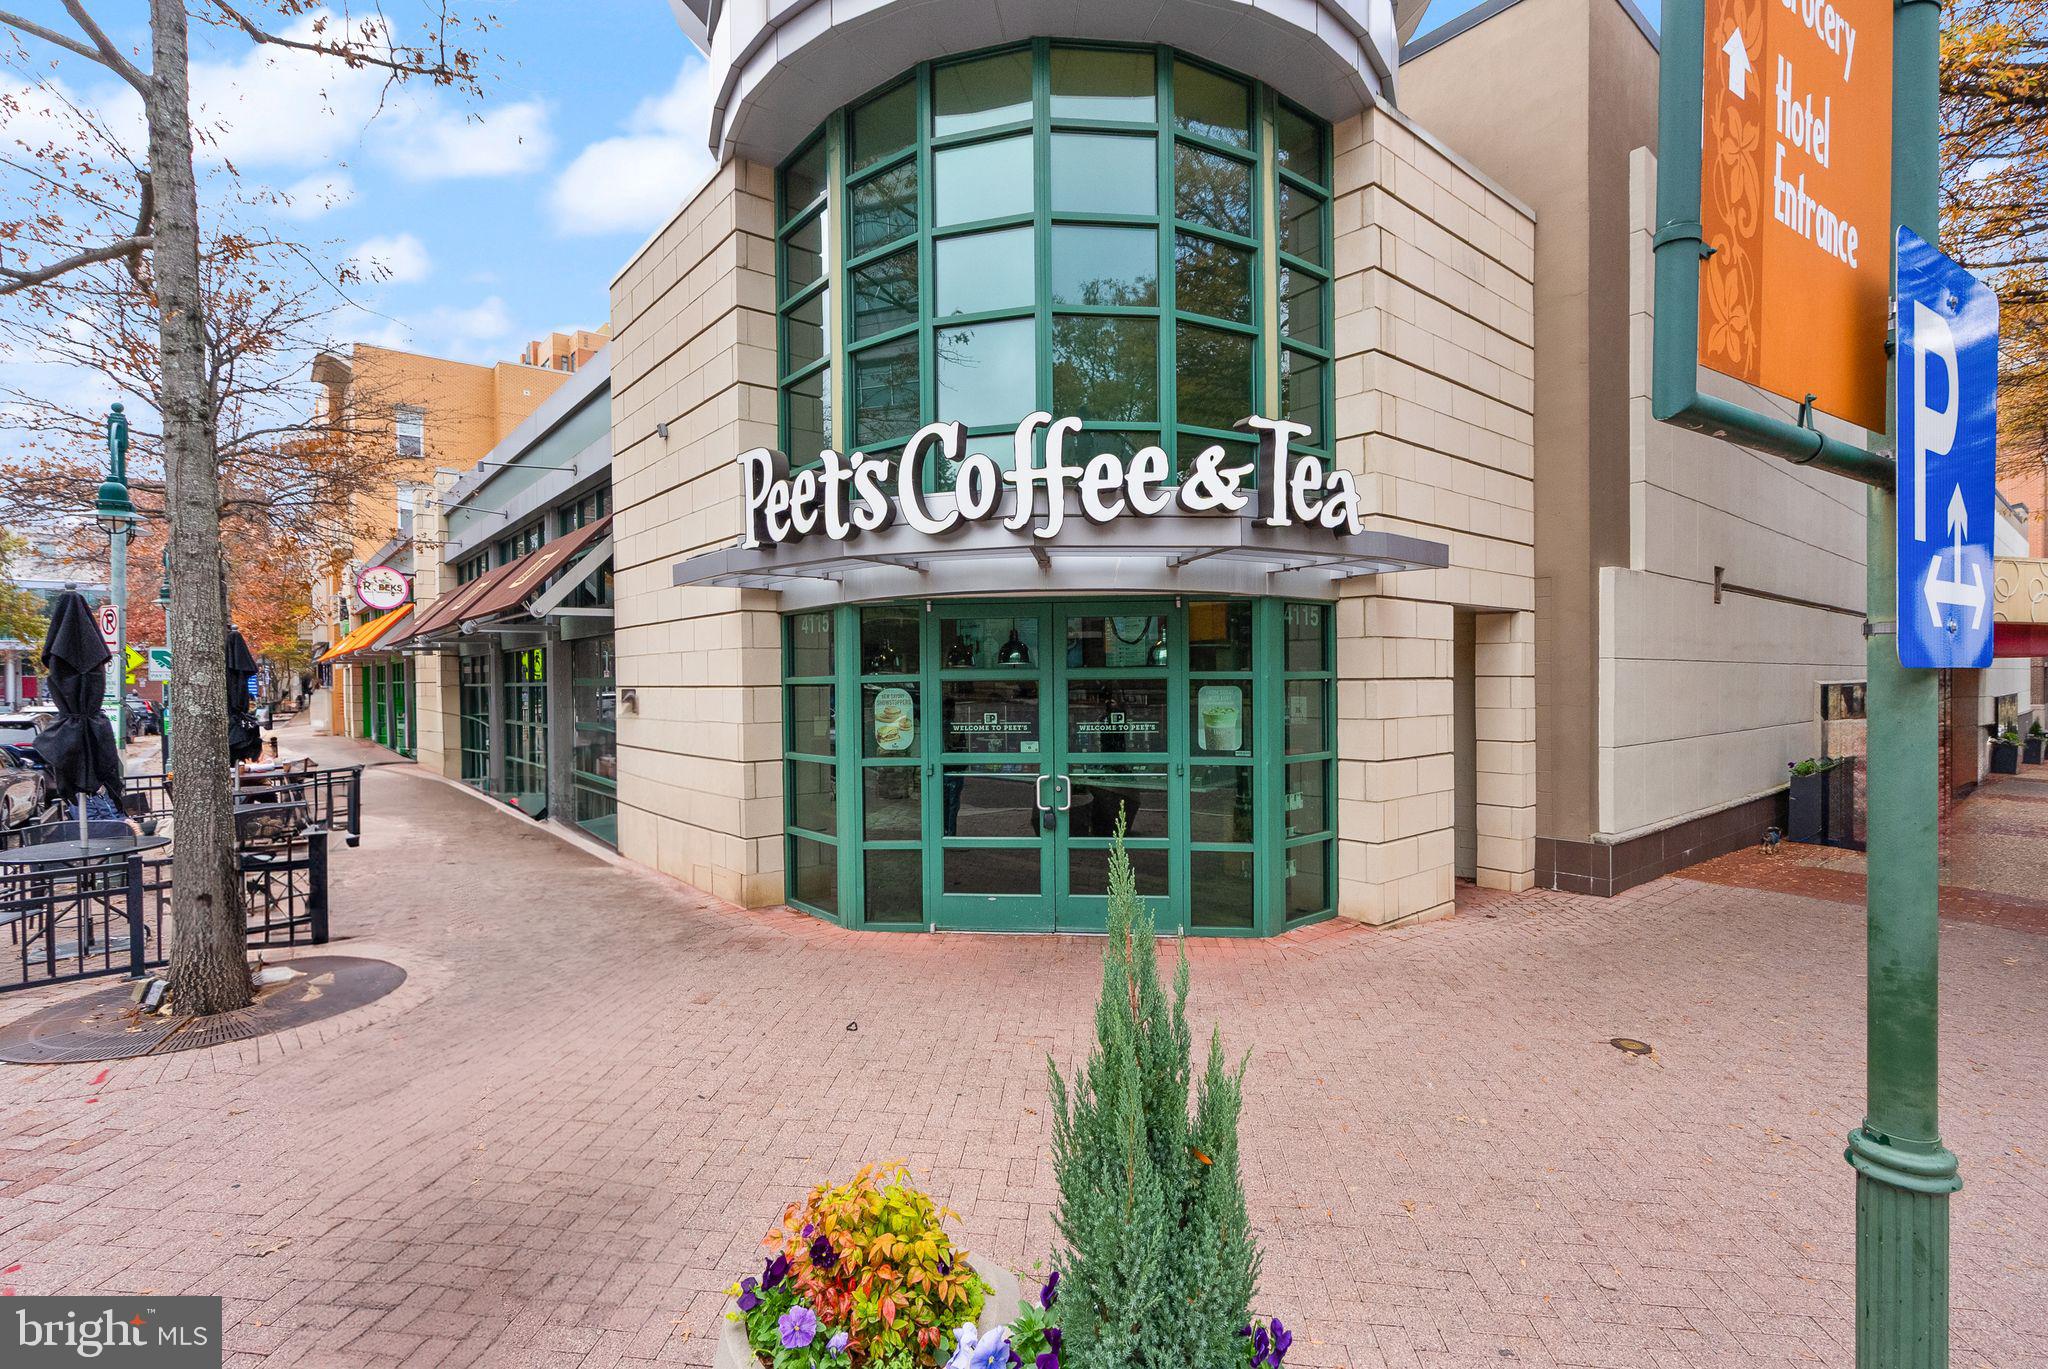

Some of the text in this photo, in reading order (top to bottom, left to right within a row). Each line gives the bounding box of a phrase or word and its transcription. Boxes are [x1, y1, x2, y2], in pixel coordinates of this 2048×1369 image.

[1781, 0, 1856, 83] ocery
[1776, 54, 1830, 169] Hotel
[1774, 141, 1858, 269] Entrance
[1914, 300, 1959, 542] P
[736, 411, 1365, 550] Peet's Coffee & Tea
[801, 614, 830, 634] 4115
[1284, 607, 1319, 626] 4115
